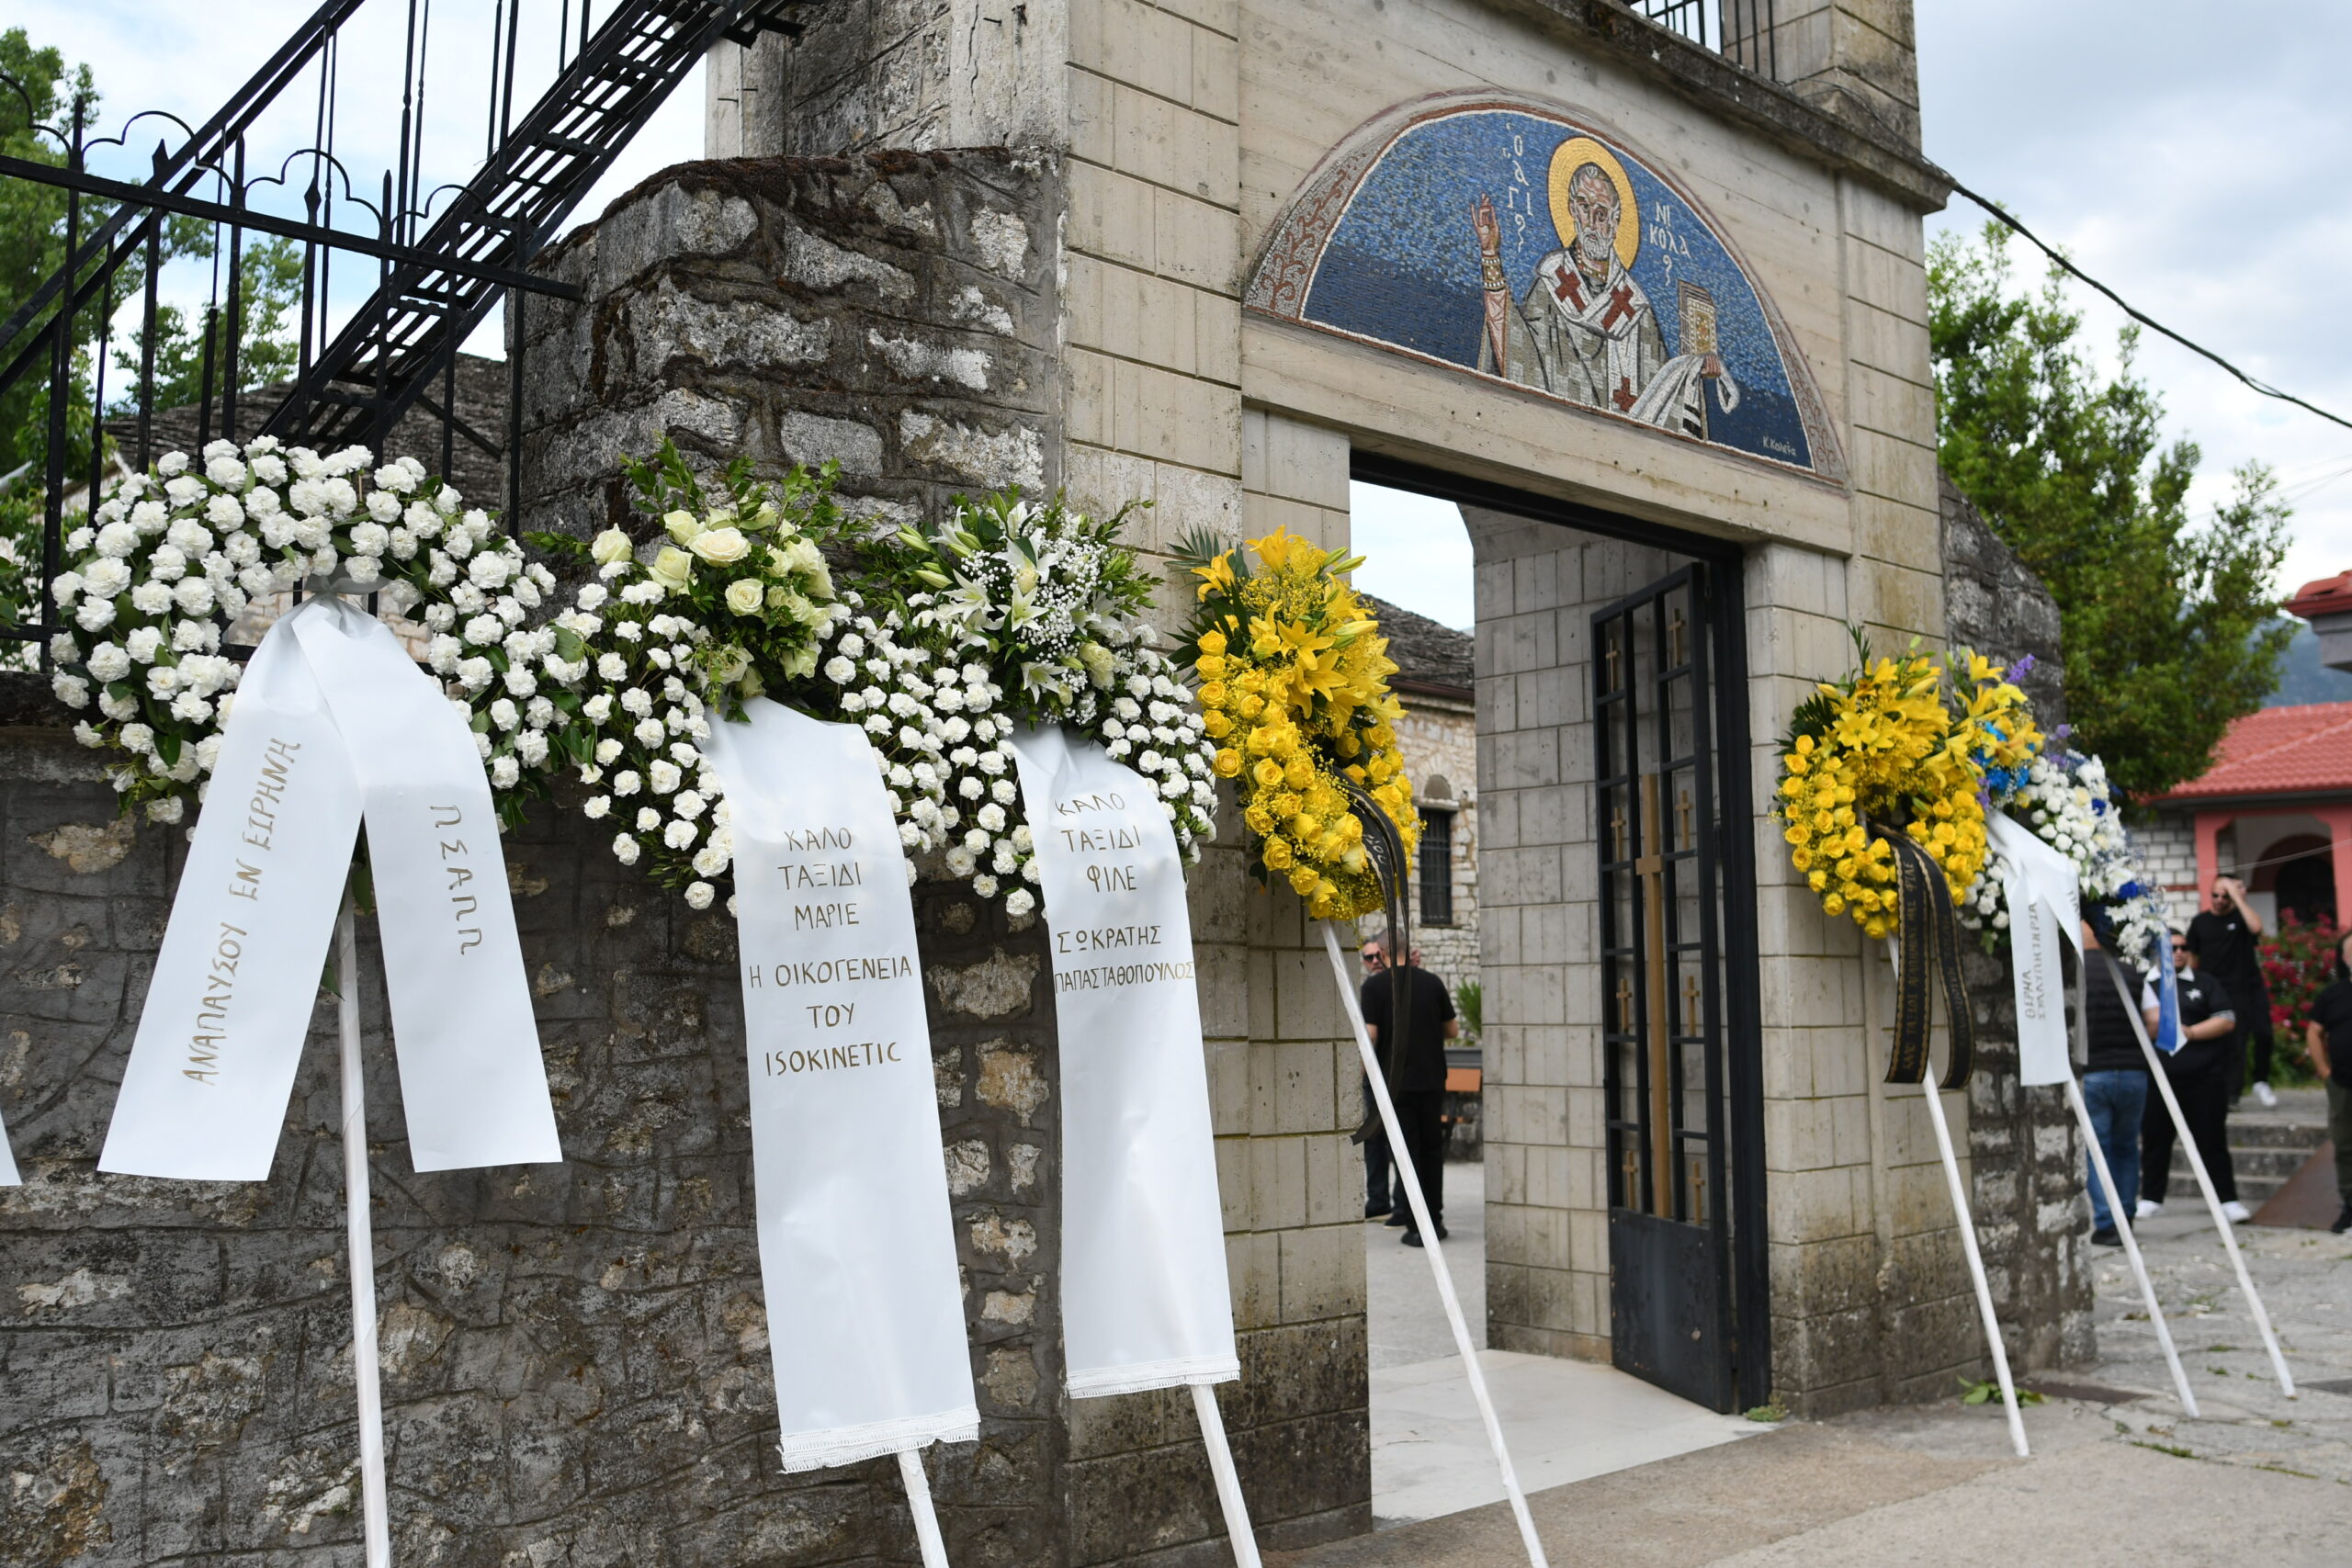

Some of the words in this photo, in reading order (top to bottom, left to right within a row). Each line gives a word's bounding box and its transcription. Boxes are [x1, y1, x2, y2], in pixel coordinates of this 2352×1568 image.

[242, 738, 301, 852] ΕΙΡΗΝΗ
[1054, 792, 1126, 817] ΚΑΛΟ
[784, 826, 853, 852] ΚΑΛΟ
[1060, 825, 1141, 853] ΤΑΞΙΔΙ
[229, 858, 263, 902] ΕΝ
[429, 805, 483, 956] ΠΣΑΠΠ
[777, 861, 862, 890] ΤΑΞΙΔΙ
[1086, 864, 1137, 893] ΦΙΛΕ
[794, 902, 860, 931] ΜΑΡΙΕ
[1057, 925, 1161, 953] ΣΩΚΡΑΤΗΣ
[749, 964, 763, 989] Η
[775, 955, 912, 987] ΟΙΚΟΓΕΝΕΙΑ
[1055, 962, 1194, 995] ΠΑΠΑΣΤΑΘΟΠΟΥΛΟΣ
[182, 921, 248, 1087] ΑΝΑΠΑΥΣΟΥ
[805, 1002, 854, 1029] ΤΟΥ
[765, 1042, 902, 1077] ISOKINETIC
